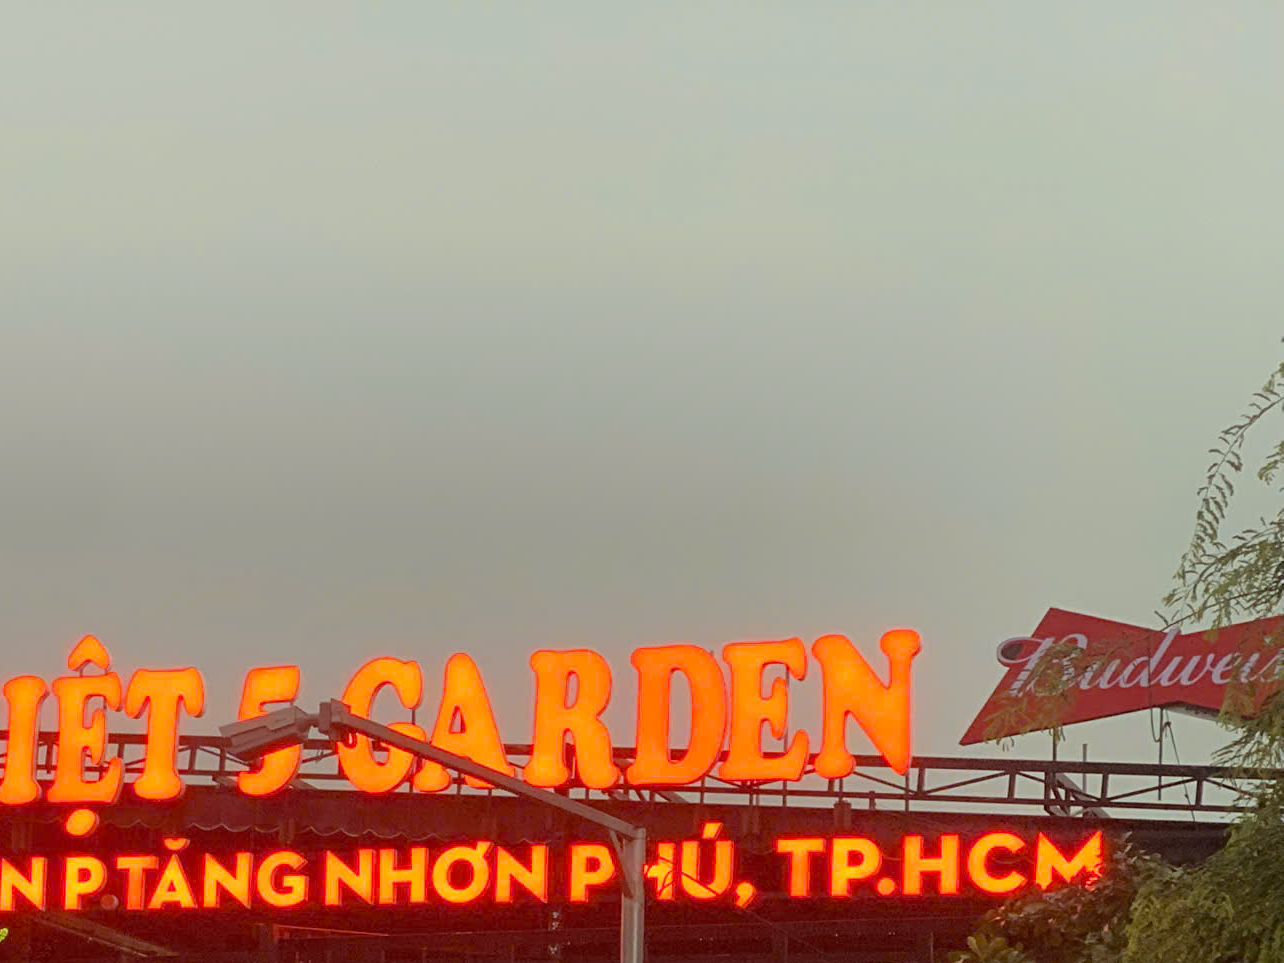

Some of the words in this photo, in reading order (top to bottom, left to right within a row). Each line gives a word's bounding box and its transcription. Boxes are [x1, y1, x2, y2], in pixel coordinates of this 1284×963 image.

[996, 627, 1284, 697] Budwei
[235, 665, 300, 796] 5
[337, 629, 922, 795] GARDEN
[324, 841, 549, 905] NHƠN
[776, 830, 1103, 897] TP.HCM
